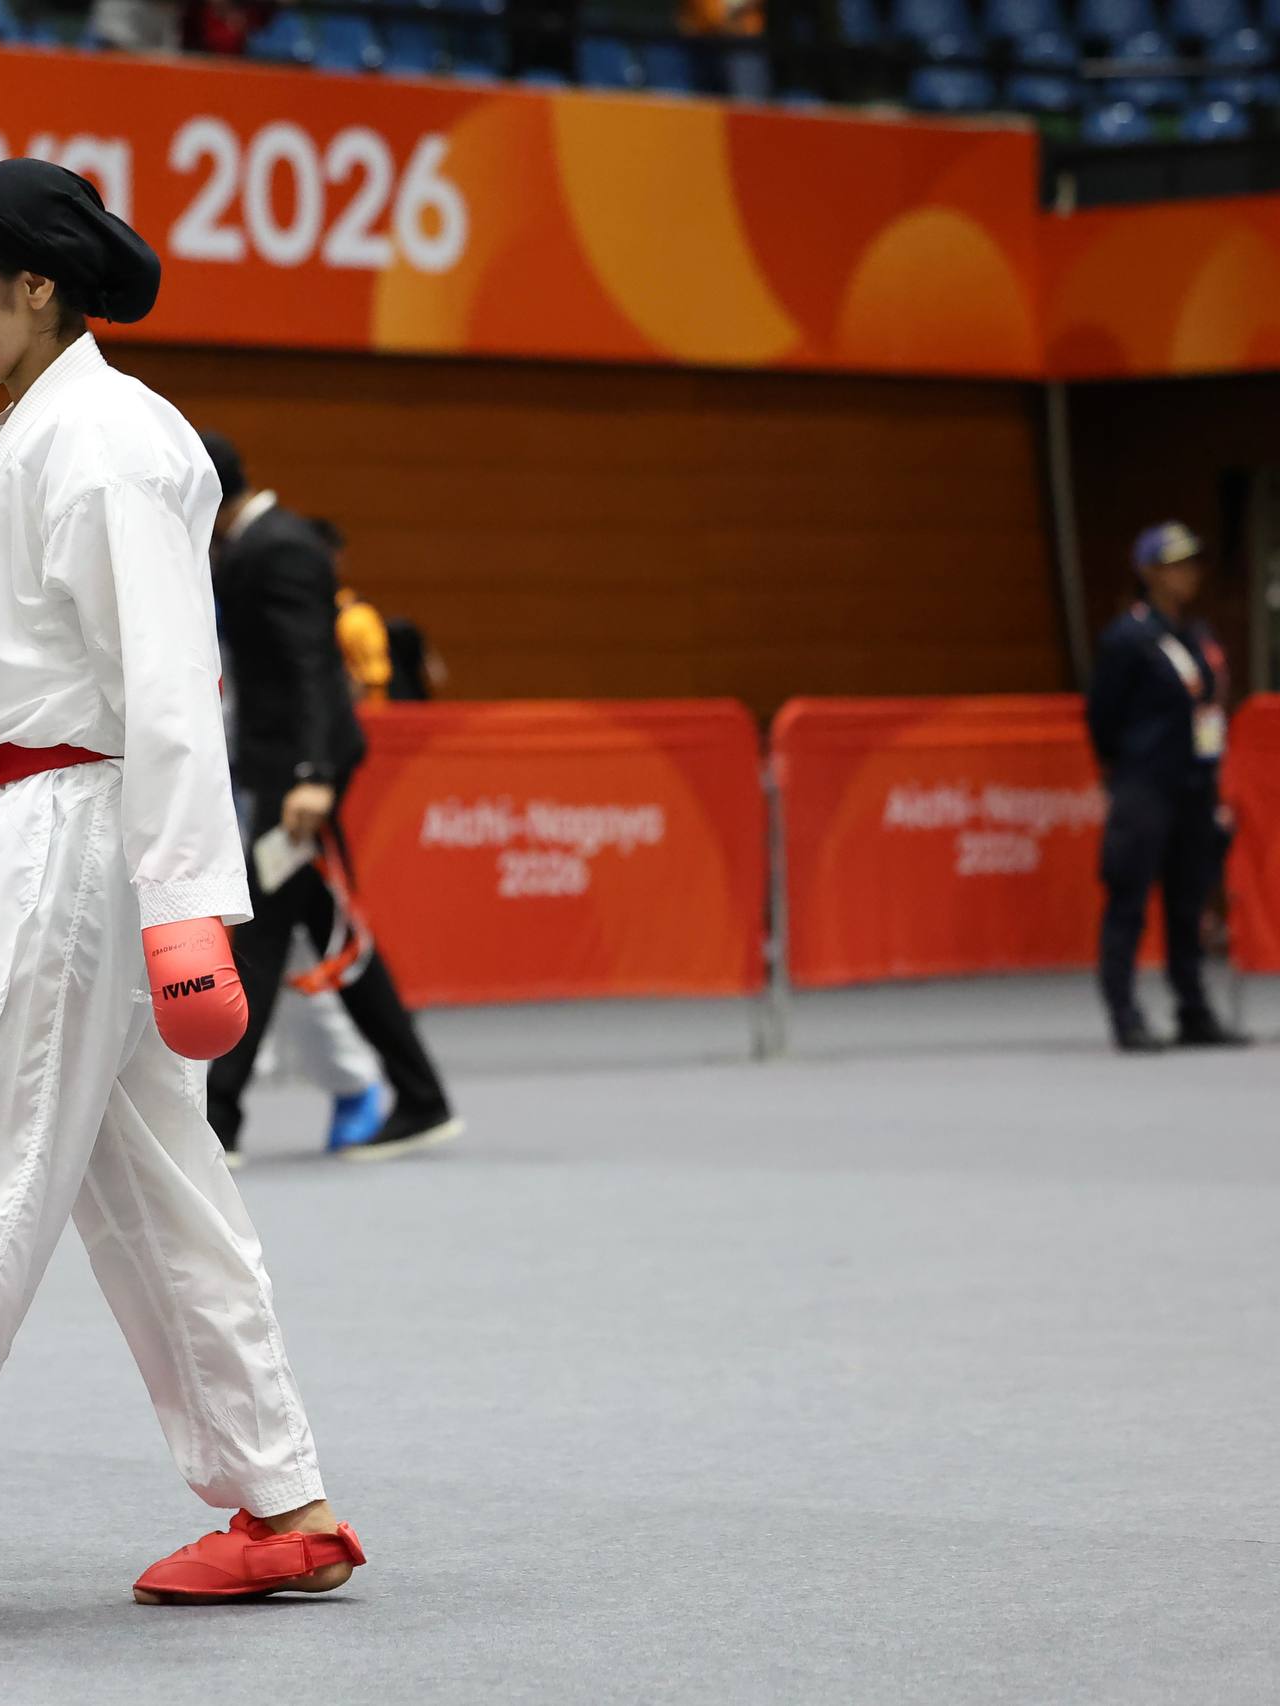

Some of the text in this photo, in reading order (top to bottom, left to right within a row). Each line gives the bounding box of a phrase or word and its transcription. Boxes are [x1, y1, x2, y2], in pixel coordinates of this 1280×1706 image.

[168, 116, 468, 273] 2026
[419, 795, 665, 858] Aichi-Nagoya
[498, 851, 591, 897] 2026
[162, 974, 215, 1001] SMAI
